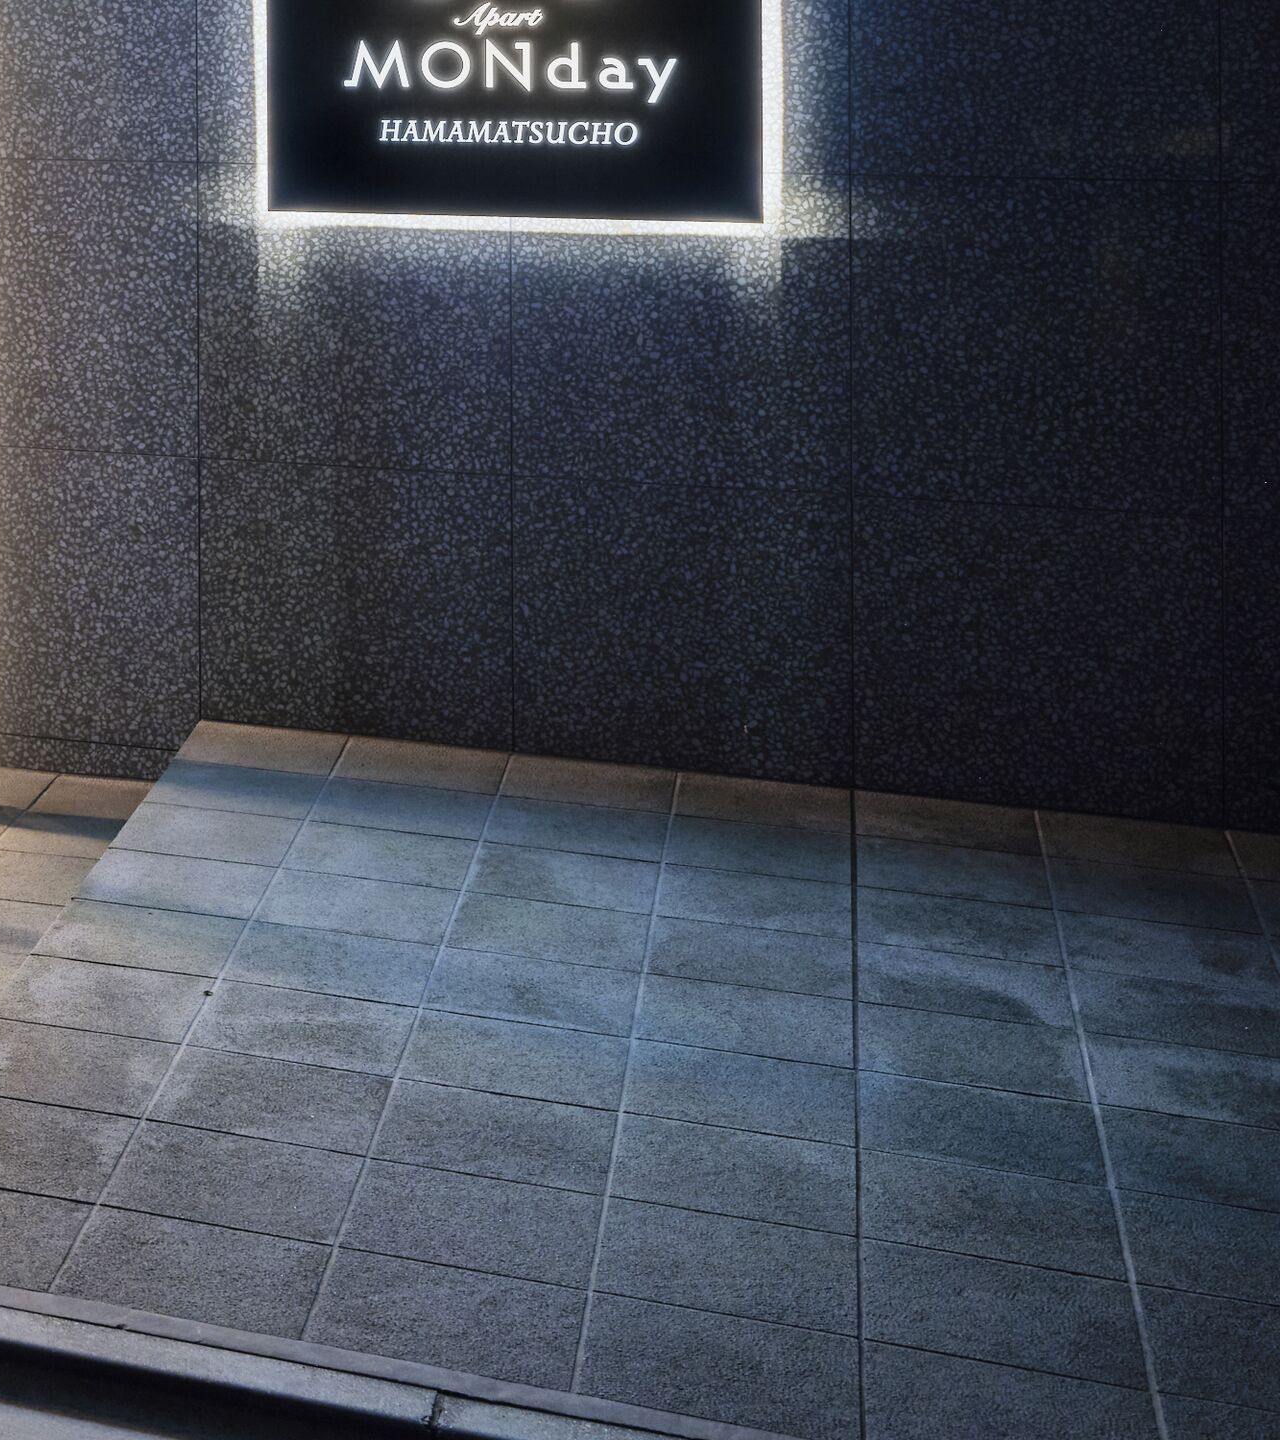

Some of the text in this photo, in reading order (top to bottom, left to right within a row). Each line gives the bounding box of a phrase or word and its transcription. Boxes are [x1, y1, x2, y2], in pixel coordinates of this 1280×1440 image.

[453, 1, 544, 35] Apart
[343, 39, 677, 104] MONday
[378, 119, 639, 146] HAMAMATSUCHO
